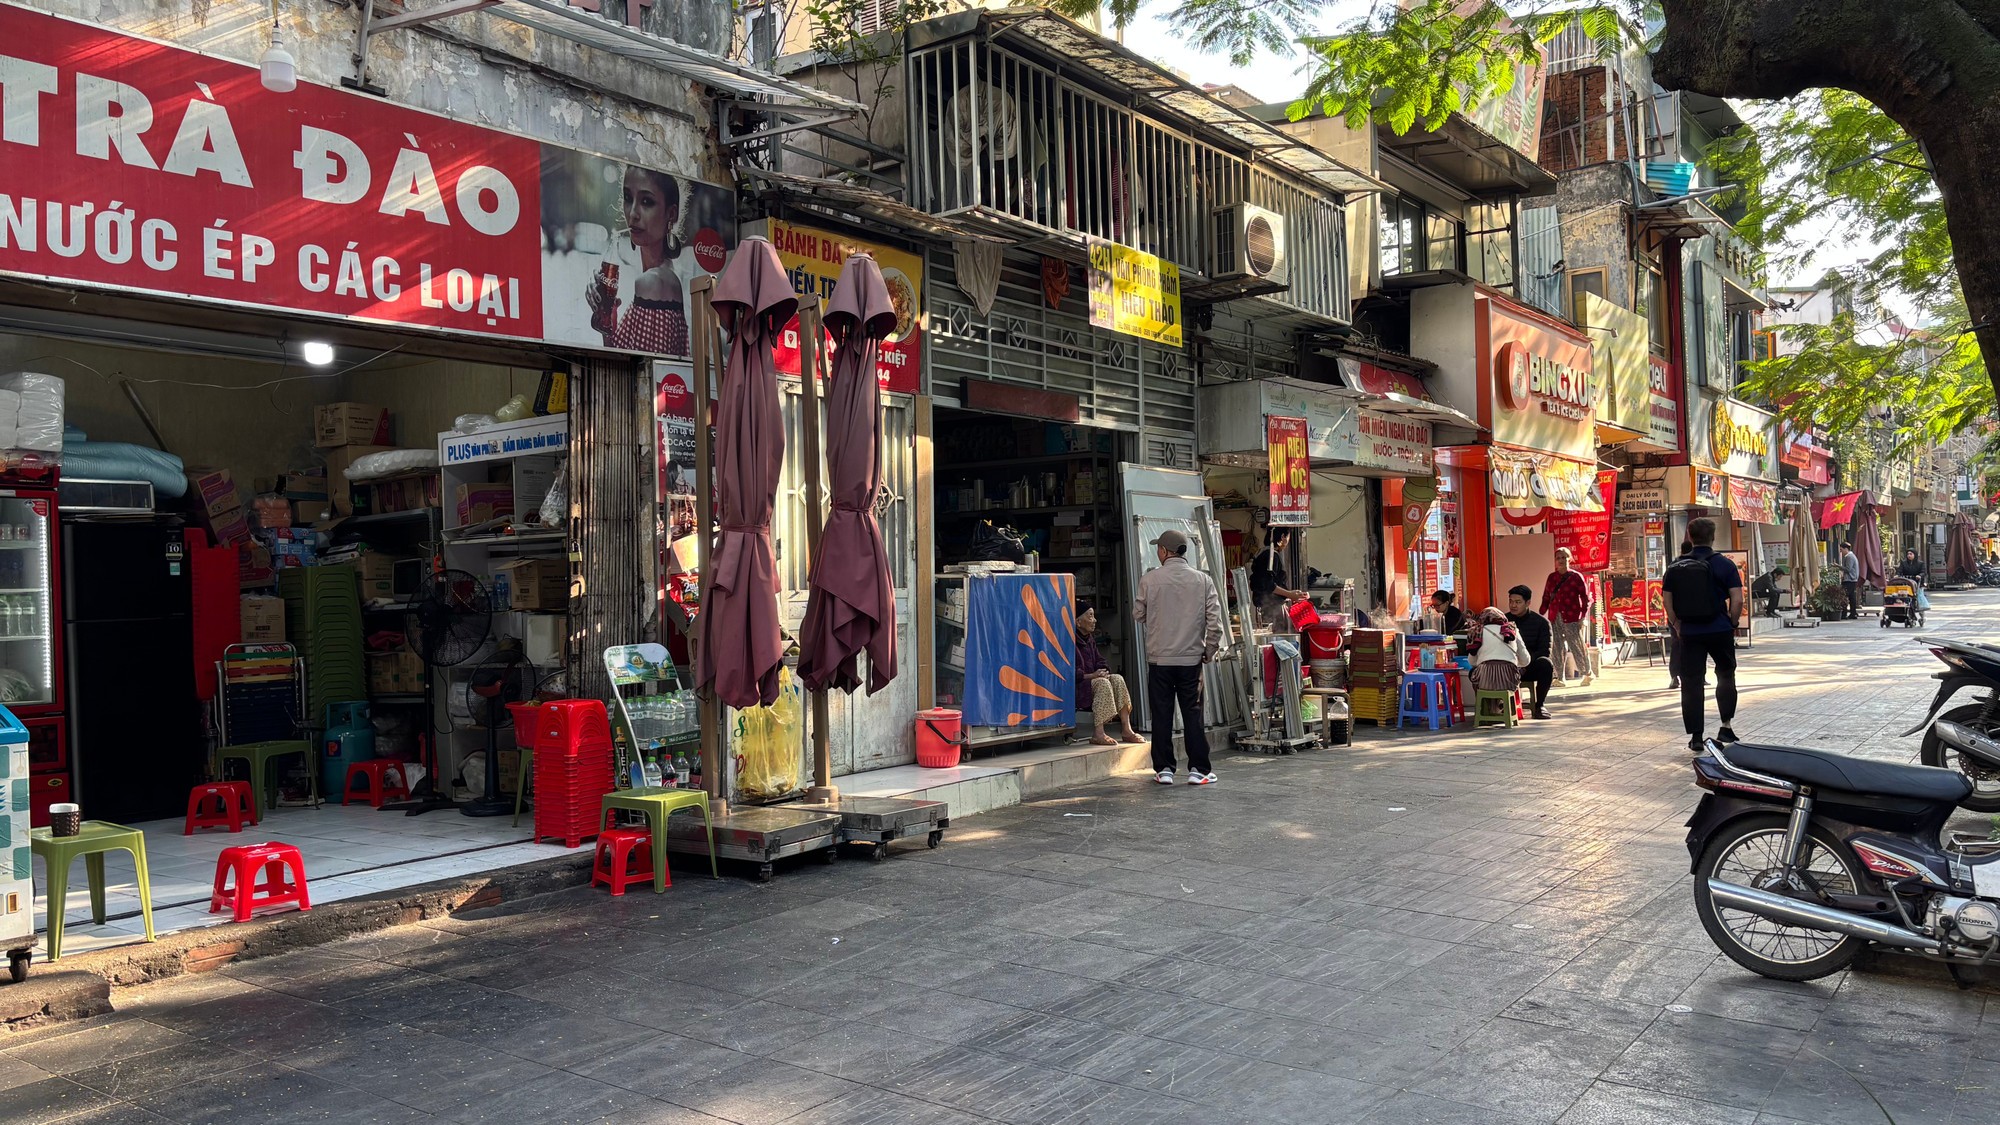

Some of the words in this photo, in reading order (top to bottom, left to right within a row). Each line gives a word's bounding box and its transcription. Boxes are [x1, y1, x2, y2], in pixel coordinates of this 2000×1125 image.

[0, 54, 254, 189] TRÀ
[293, 124, 521, 236] ĐÀO
[0, 193, 179, 272] NƯỚC
[203, 218, 276, 283] ÉP
[298, 241, 402, 302] CÁC
[419, 262, 521, 326] LOẠI
[774, 226, 817, 259] BÁNH
[822, 239, 843, 266] ĐA
[1090, 243, 1112, 274] 42H
[1116, 257, 1131, 282] VĂN
[1133, 262, 1157, 291] PHÒNG
[1149, 297, 1175, 325] THẢO
[885, 350, 908, 368] KIỆT
[1528, 352, 1597, 411] BINGXUE
[503, 435, 516, 452] HẨM
[1389, 420, 1406, 442] NGAN
[448, 443, 471, 461] PLUS
[1291, 459, 1307, 489] ỐC
[168, 545, 180, 553] 10
[1871, 858, 1913, 873] Dream
[1958, 916, 1993, 926] HONDA
